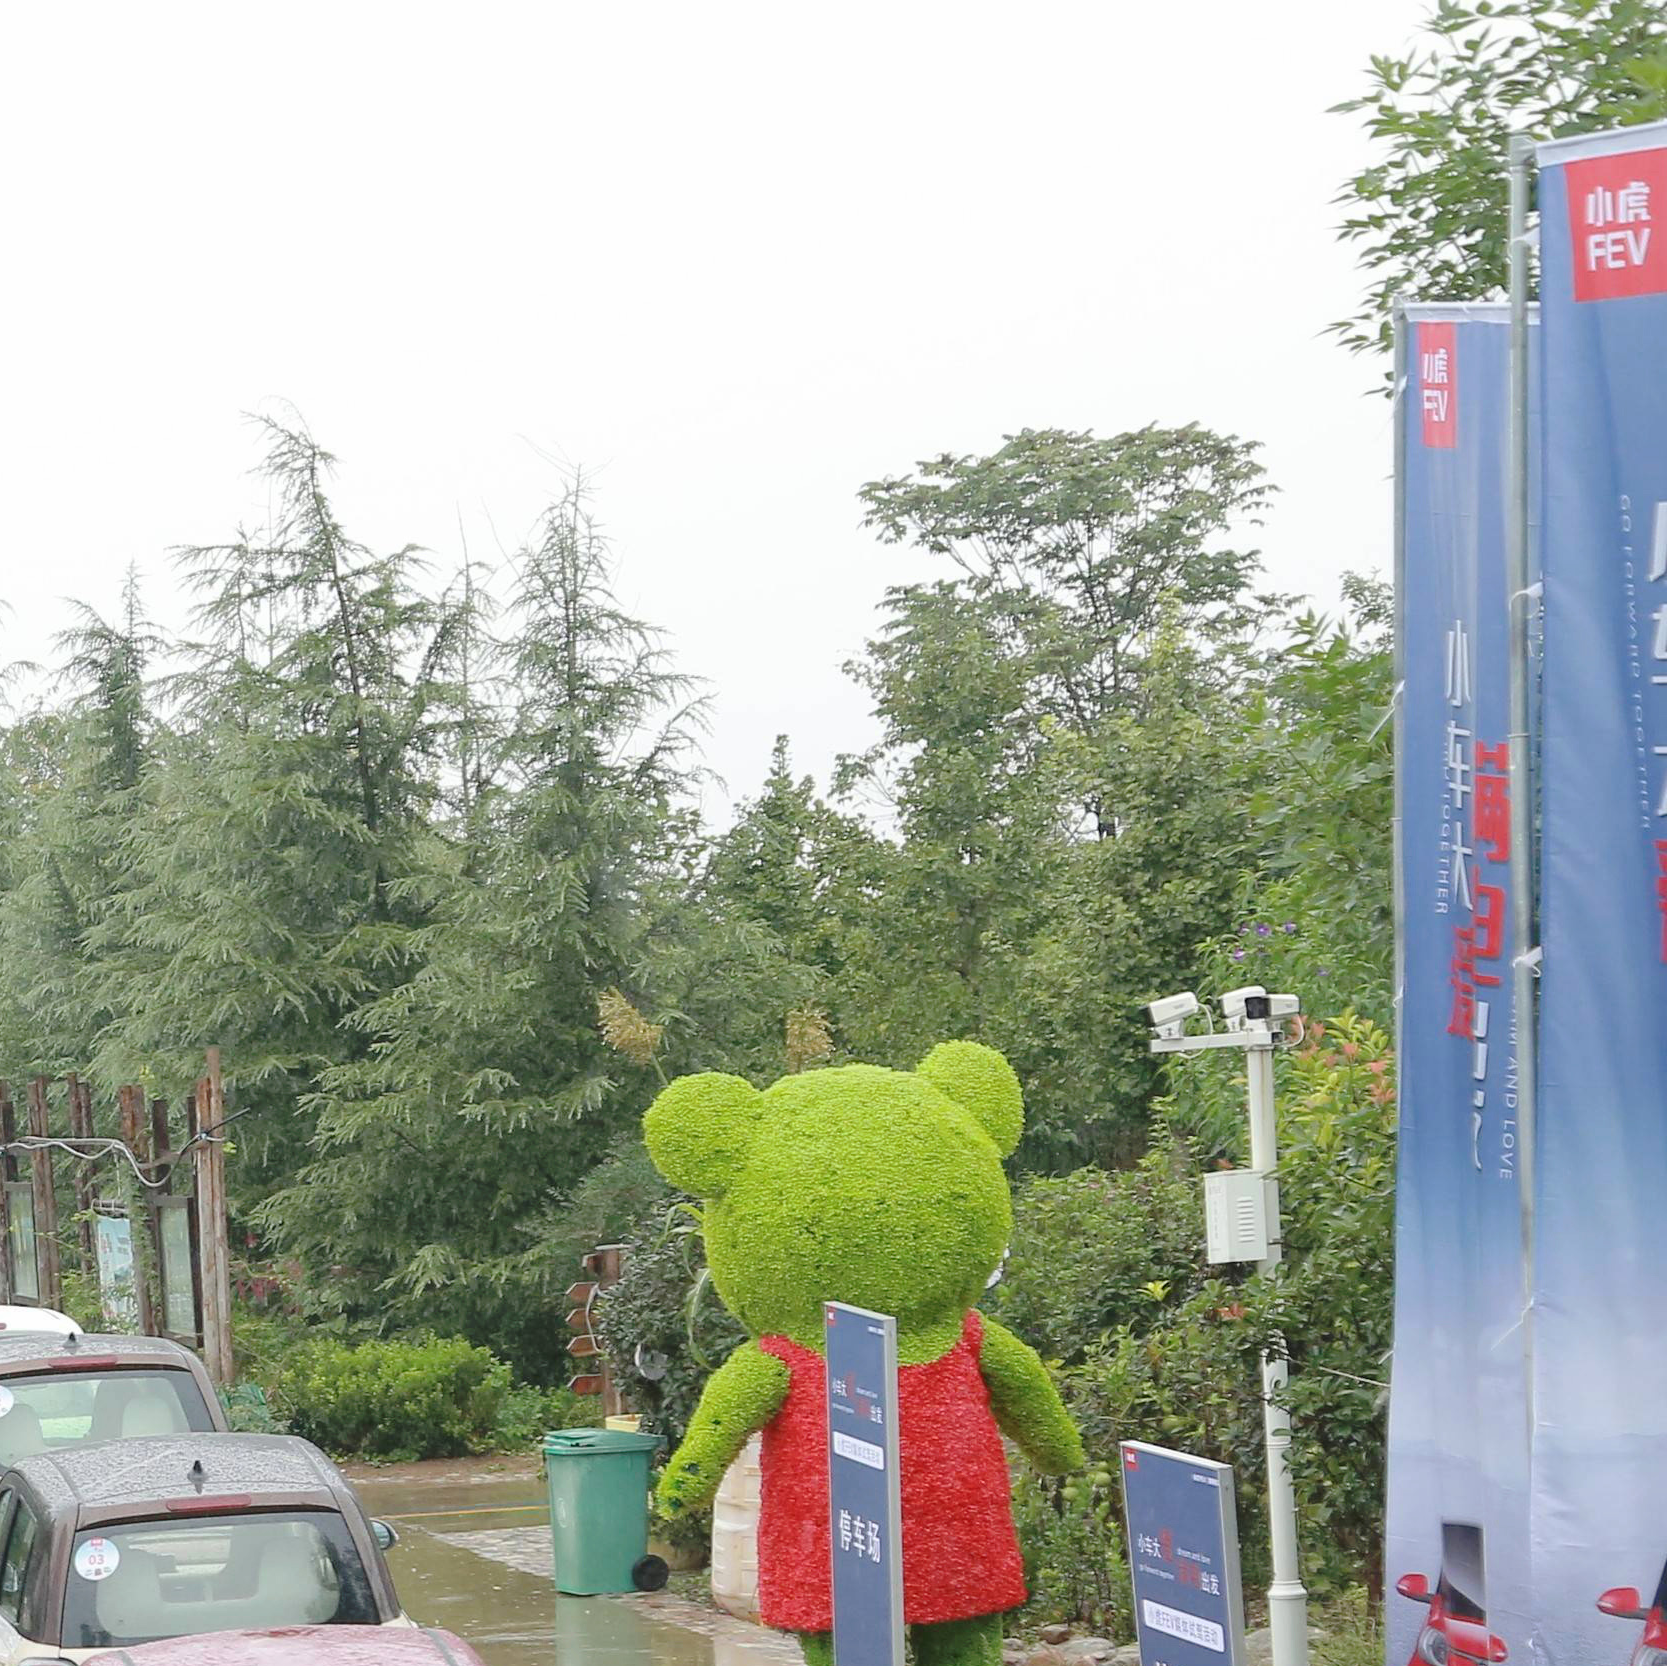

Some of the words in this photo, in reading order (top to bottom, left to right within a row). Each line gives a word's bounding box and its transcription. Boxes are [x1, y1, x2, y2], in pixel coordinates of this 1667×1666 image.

[1586, 181, 1652, 227] 小虎
[1588, 228, 1652, 271] FEV
[1499, 1119, 1515, 1179] LOVE
[87, 1553, 105, 1566] 03
[839, 1508, 882, 1565] 停车场
